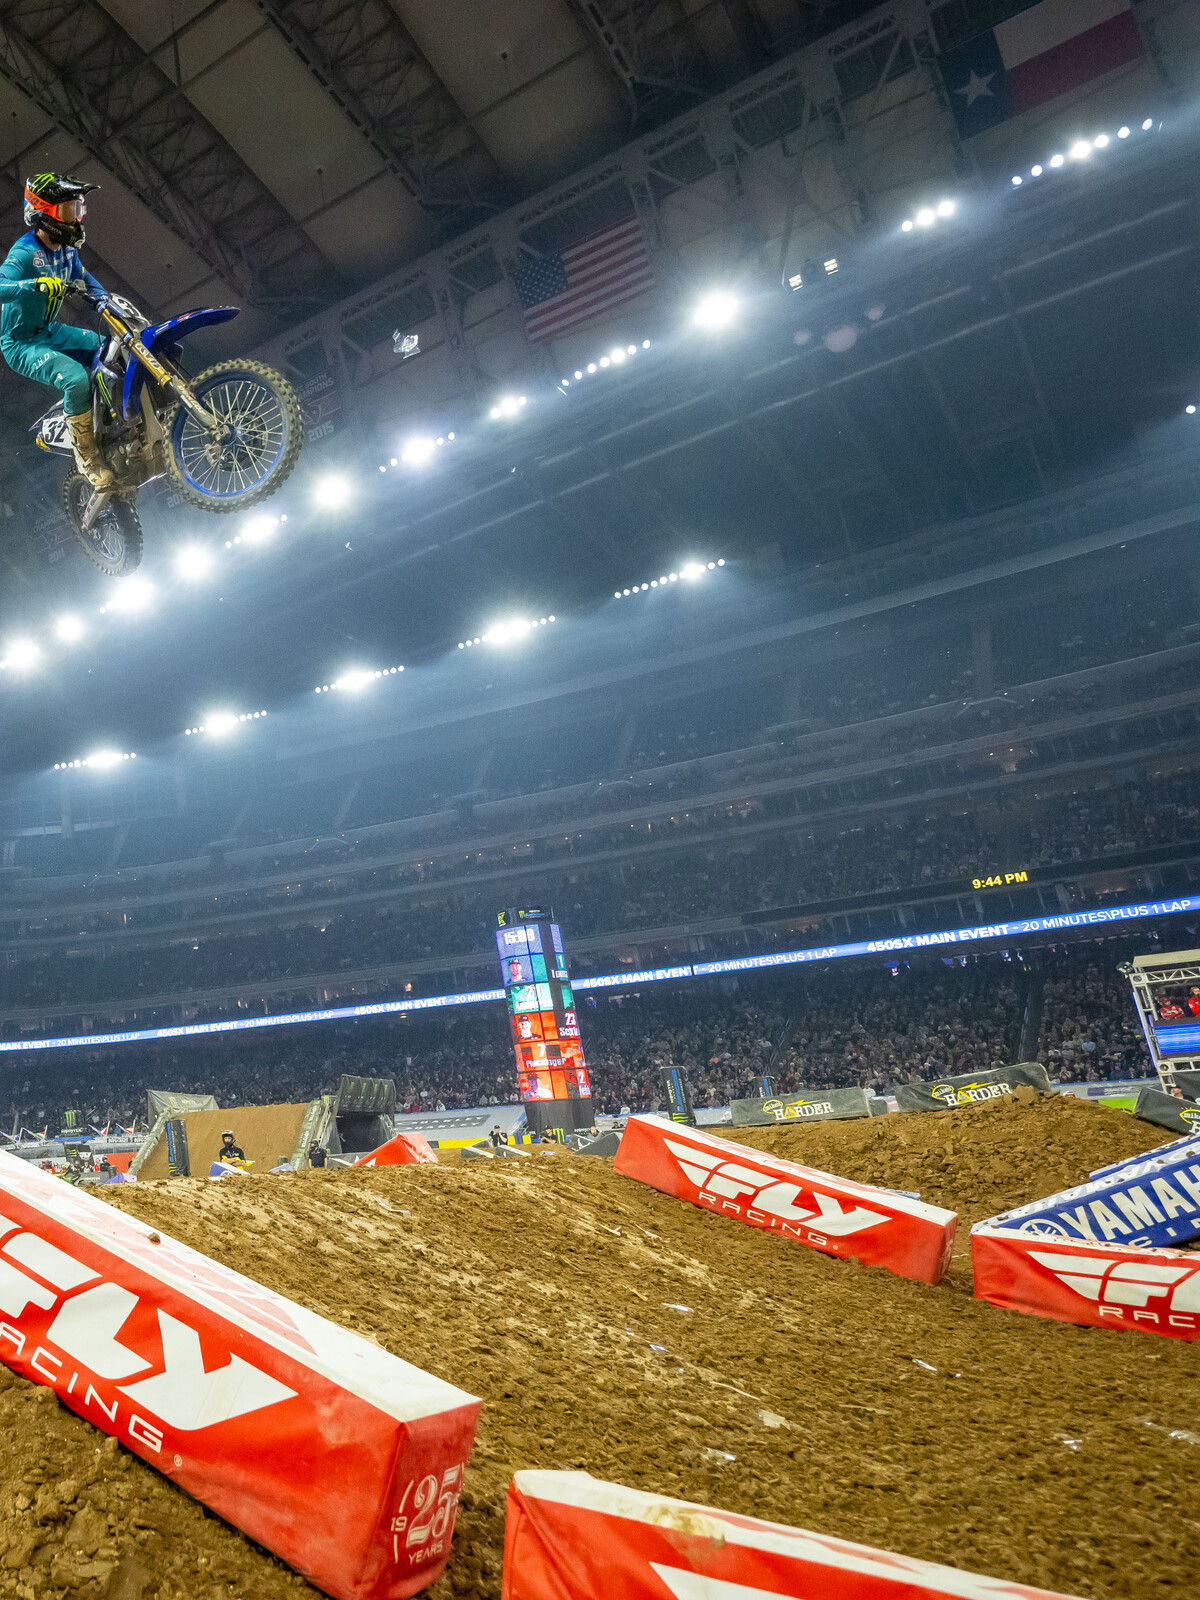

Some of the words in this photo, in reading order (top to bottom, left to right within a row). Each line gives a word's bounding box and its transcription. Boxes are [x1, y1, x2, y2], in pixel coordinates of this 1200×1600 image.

[25, 188, 49, 213] 00%
[45, 421, 67, 443] 32
[972, 875, 1002, 890] 9:44
[1005, 871, 1028, 884] PM
[867, 938, 913, 953] 450SX
[916, 932, 956, 947] MAIN
[959, 924, 1009, 942] EVENT
[1021, 921, 1039, 932] 20
[1162, 900, 1191, 914] LAP
[584, 976, 620, 988] 450SX
[622, 973, 653, 985] MAIN
[655, 966, 698, 982] EVENT
[708, 963, 721, 973] 20
[815, 948, 837, 959] LAP
[354, 1004, 385, 1015] 450SX
[387, 1001, 413, 1012] MAIN
[415, 997, 446, 1009] EVENT
[454, 994, 466, 1004] 20
[468, 990, 506, 1003] MINUTES
[537, 1043, 546, 1057] 7
[773, 1102, 833, 1121] HARDER
[663, 1137, 893, 1236] FLY
[698, 1191, 827, 1247] RACING
[1099, 1305, 1196, 1328] RAC
[406, 1464, 460, 1548] 25
[390, 1516, 407, 1531] 19
[409, 1541, 443, 1565] YEARS
